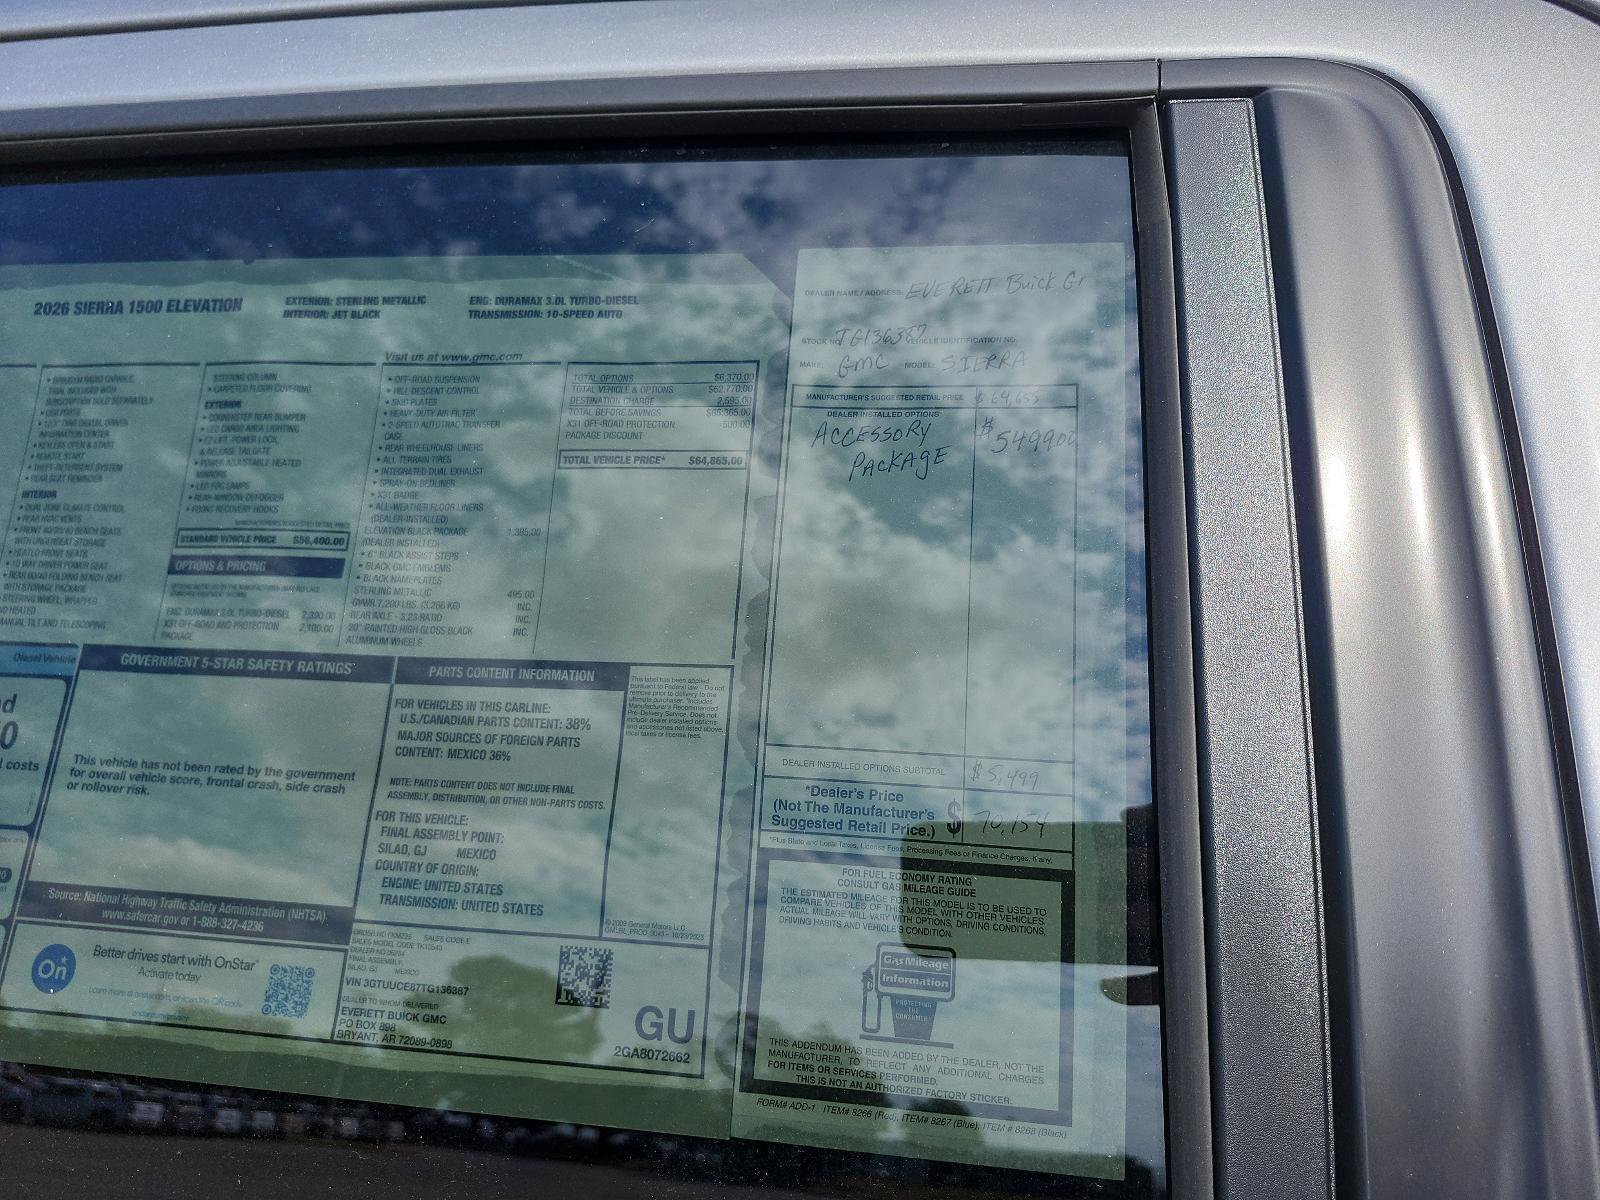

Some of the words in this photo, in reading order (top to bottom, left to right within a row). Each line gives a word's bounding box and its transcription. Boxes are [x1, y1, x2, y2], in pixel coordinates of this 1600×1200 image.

[1006, 273, 1056, 294] Buick
[34, 301, 70, 316] 2026
[73, 300, 124, 315] SIERRA
[128, 299, 163, 314] 1500
[166, 297, 243, 313] ELEVATION
[286, 296, 333, 306] EXTERIOR:
[336, 296, 380, 306] STERLING
[382, 295, 427, 305] METALLIC
[470, 296, 492, 305] ENG:
[495, 296, 542, 305] DURAMAX
[570, 296, 639, 305] TURBO-DIESEL
[283, 310, 329, 319] INTERIOR:
[332, 310, 348, 319] JET
[351, 310, 380, 319] BLACK
[468, 310, 543, 319] TRANSMISSION:
[546, 310, 595, 319] 10-SPEED
[597, 310, 622, 319] AUTO
[385, 352, 408, 361] Visit
[427, 353, 440, 361] at
[441, 352, 523, 363] www.gmc.com
[573, 374, 597, 382] TOTAL
[600, 374, 634, 382] OPTIONS
[563, 455, 590, 465] TOTAL
[593, 456, 631, 465] VEHICLE
[121, 653, 199, 668] GOVERNMENT
[201, 656, 244, 671] 5-STAR
[248, 658, 294, 673] SAFETY
[429, 666, 463, 678] PARTS
[466, 667, 515, 680] CONTENT
[518, 669, 595, 682] INFORMATION
[395, 698, 414, 709] FOR
[417, 699, 463, 711] VEHICLES
[466, 701, 477, 711] IN
[480, 701, 502, 712] THIS
[504, 702, 551, 713] CARLINE:
[400, 713, 475, 726] U.S./CANADIAN
[477, 716, 510, 727] PARTS
[513, 717, 563, 729] CONTENT:
[565, 718, 591, 731] 38%
[398, 730, 433, 742] MAJOR
[435, 731, 482, 744] SOURCES
[485, 733, 498, 744] OF
[500, 735, 544, 746] FOREIGN
[546, 736, 581, 748] PARTS
[395, 746, 443, 759] CONTENT:
[447, 748, 486, 761] MEXICO
[489, 750, 511, 762] 36%
[6, 760, 40, 771] costs
[73, 753, 97, 766] This
[100, 755, 138, 768] vehicle
[141, 757, 160, 770] has
[163, 759, 181, 771] not
[184, 760, 211, 773] been
[214, 763, 244, 775] rated
[247, 764, 261, 778] by
[264, 766, 282, 778] the
[285, 768, 356, 782] government
[67, 782, 78, 790] or
[81, 782, 124, 794] rollover
[127, 784, 151, 796] risk.
[70, 767, 86, 778] for
[88, 769, 126, 781] overall
[129, 772, 167, 784] vehicle
[170, 775, 203, 787] score,
[206, 775, 244, 788] frontal
[247, 778, 282, 792] crash,
[285, 780, 310, 793] side
[312, 782, 346, 795] crash
[868, 787, 904, 803] Price
[375, 810, 396, 822] FOR
[399, 811, 422, 824] THIS
[424, 813, 469, 827] VEHICLE:
[773, 798, 803, 814] (Not
[805, 799, 829, 814] The
[833, 803, 935, 821] Manufacturer's
[947, 798, 962, 837] $
[381, 826, 410, 839] FINAL
[413, 828, 468, 842] ASSEMBLY
[471, 831, 505, 844] POINT:
[771, 813, 843, 833] Suggested
[849, 818, 887, 834] Retail
[890, 821, 936, 839] Price.)
[413, 844, 427, 857] GJ
[457, 847, 497, 861] MEXICO
[375, 859, 424, 874] COUNTRY
[426, 862, 439, 874] OF
[441, 863, 480, 878] ORIGIN:
[842, 868, 862, 879] FOR
[863, 868, 887, 880] FUEL
[888, 869, 935, 883] ECONOMY
[938, 875, 973, 886] RATING
[381, 876, 422, 891] ENGINE:
[424, 880, 462, 894] UNITED
[464, 882, 504, 896] STATES
[837, 879, 880, 890] CONSULT
[881, 880, 901, 891] GAS
[904, 883, 945, 896] MILEAGE
[948, 886, 977, 898] GUIDE
[380, 893, 459, 911] TRANSMISSION:
[461, 899, 500, 914] UNITED
[502, 903, 545, 917] STATES
[101, 909, 179, 927] www.safercar.gov
[180, 915, 190, 926] or
[193, 916, 264, 932] 1-888-327-4236
[93, 944, 126, 960] Better
[128, 948, 159, 963] drives
[161, 952, 185, 966] start
[187, 953, 212, 968] with
[883, 954, 904, 967] Gas
[905, 957, 949, 971] Mileage
[38, 958, 67, 980] On
[138, 966, 174, 980] Activate
[174, 971, 201, 984] today
[345, 977, 362, 987] VIN
[881, 973, 949, 989] Information
[338, 1018, 353, 1029] PO
[355, 1020, 377, 1031] BOX
[379, 1022, 396, 1032] 898
[340, 1007, 385, 1019] EVERETT
[387, 1011, 420, 1022] BUICK
[422, 1014, 448, 1025] GMC
[634, 1005, 696, 1044] GU
[336, 1029, 379, 1043] BRYANT,
[382, 1033, 396, 1044] AR
[399, 1035, 453, 1049] 72089-0898
[613, 1045, 691, 1064] 2GA8072662
[796, 1074, 816, 1085] THIS
[818, 1077, 826, 1086] IS
[829, 1078, 848, 1088] NOT
[850, 1080, 863, 1090] AN
[865, 1082, 923, 1096] AUTHORIZED
[925, 1089, 967, 1101] FACTORY
[970, 1093, 1014, 1106] STICKER.
[756, 1098, 787, 1109] FORM#
[789, 1101, 816, 1112] ADD-1
[823, 1105, 850, 1116] ITEM#
[852, 1107, 872, 1118] 8266
